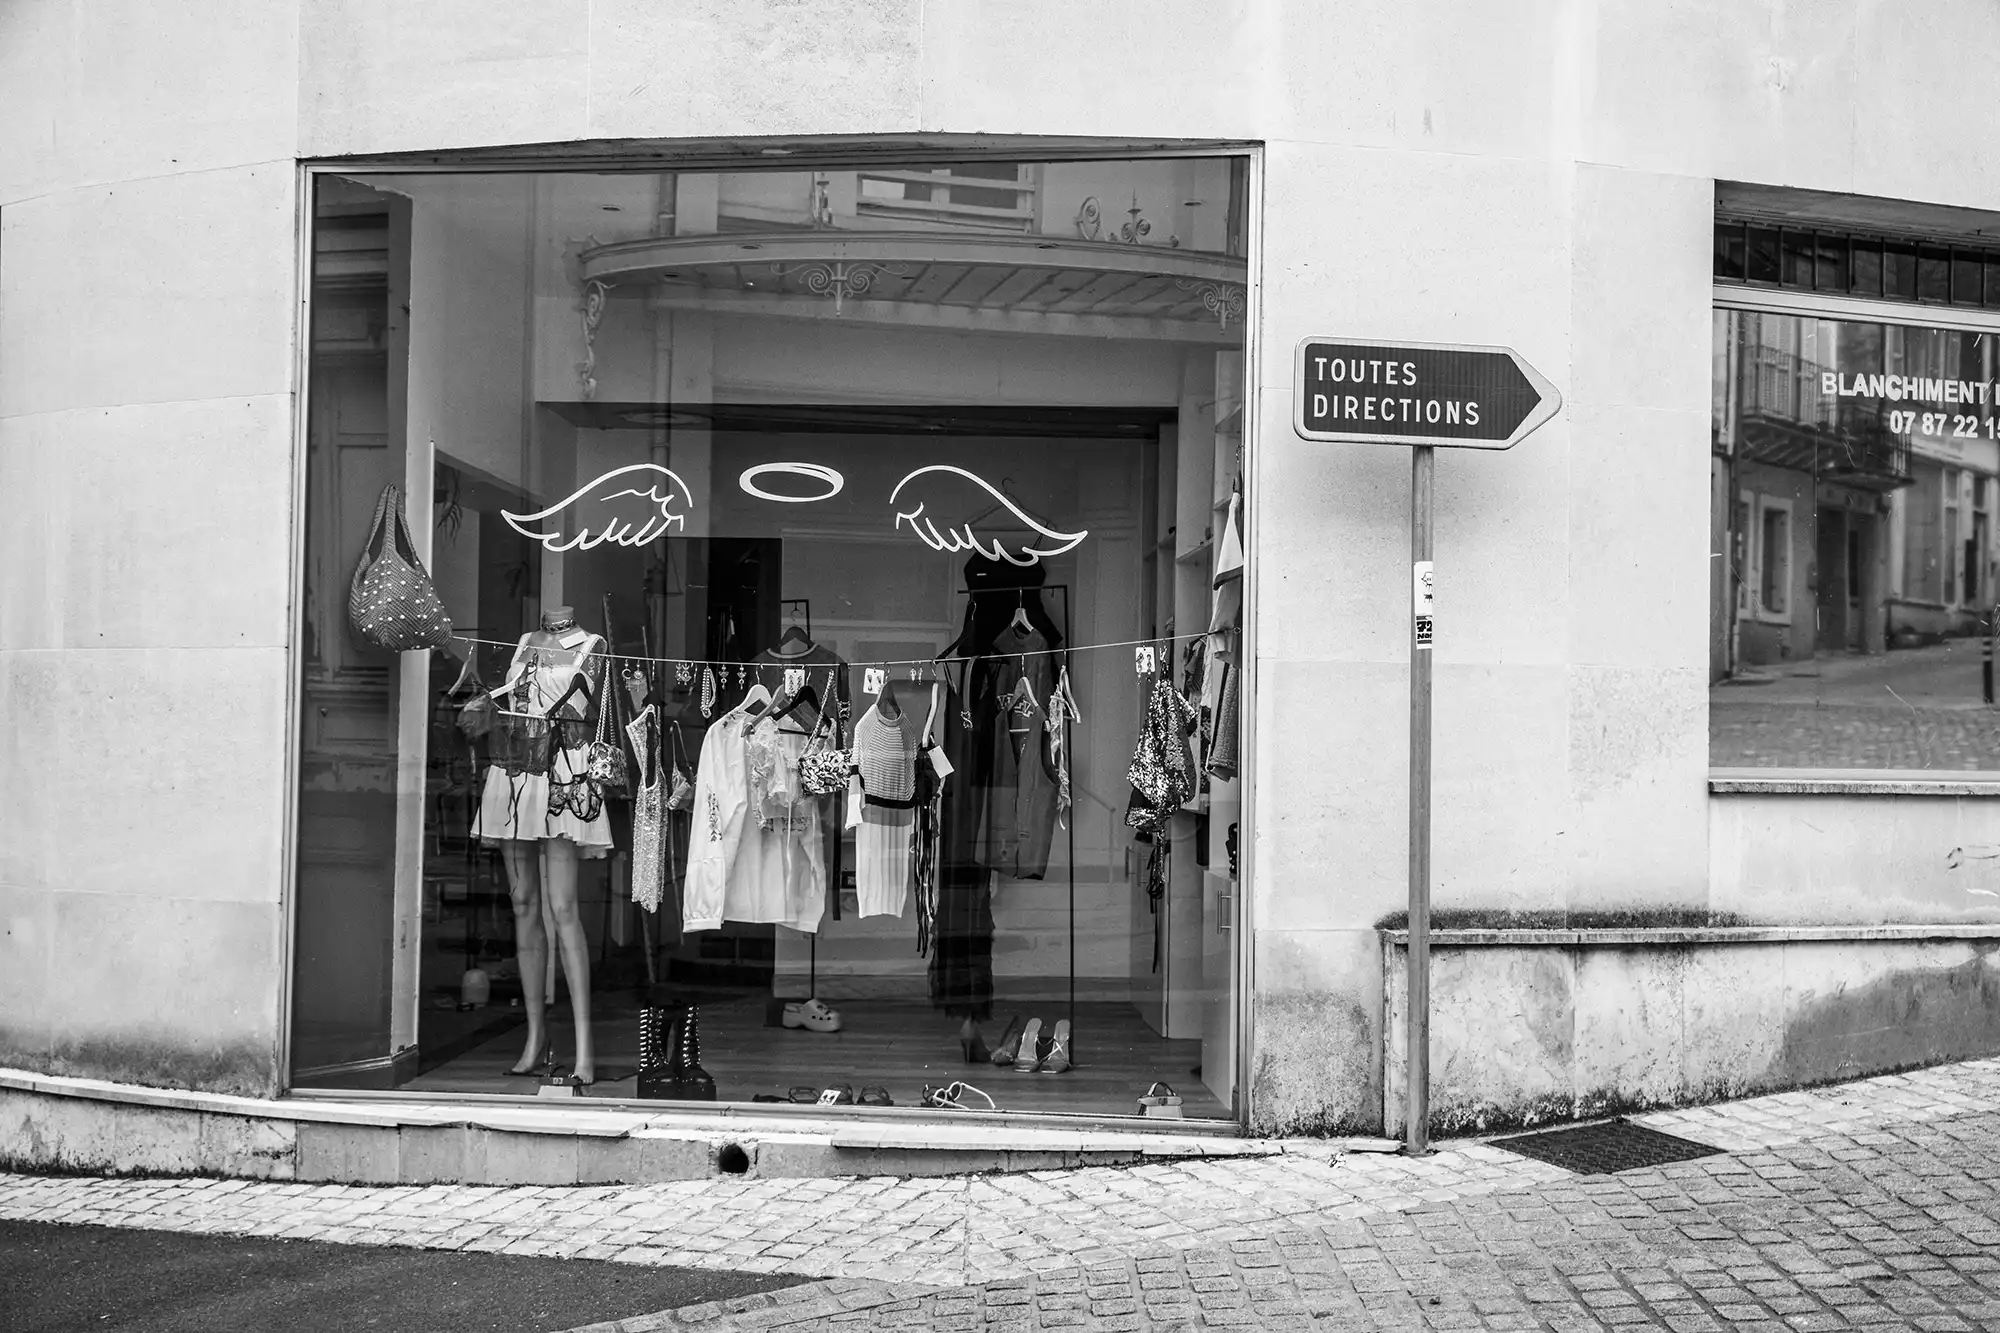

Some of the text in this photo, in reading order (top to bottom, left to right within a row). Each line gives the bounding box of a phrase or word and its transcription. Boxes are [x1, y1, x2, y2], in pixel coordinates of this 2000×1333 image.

[1315, 357, 1417, 386] TOUTES
[1822, 372, 1989, 405] BLANCHIMENT
[1313, 394, 1480, 426] DIRECTIONS
[1890, 410, 1916, 434] 07
[1922, 412, 1947, 436] 87
[1953, 414, 1978, 438] 22
